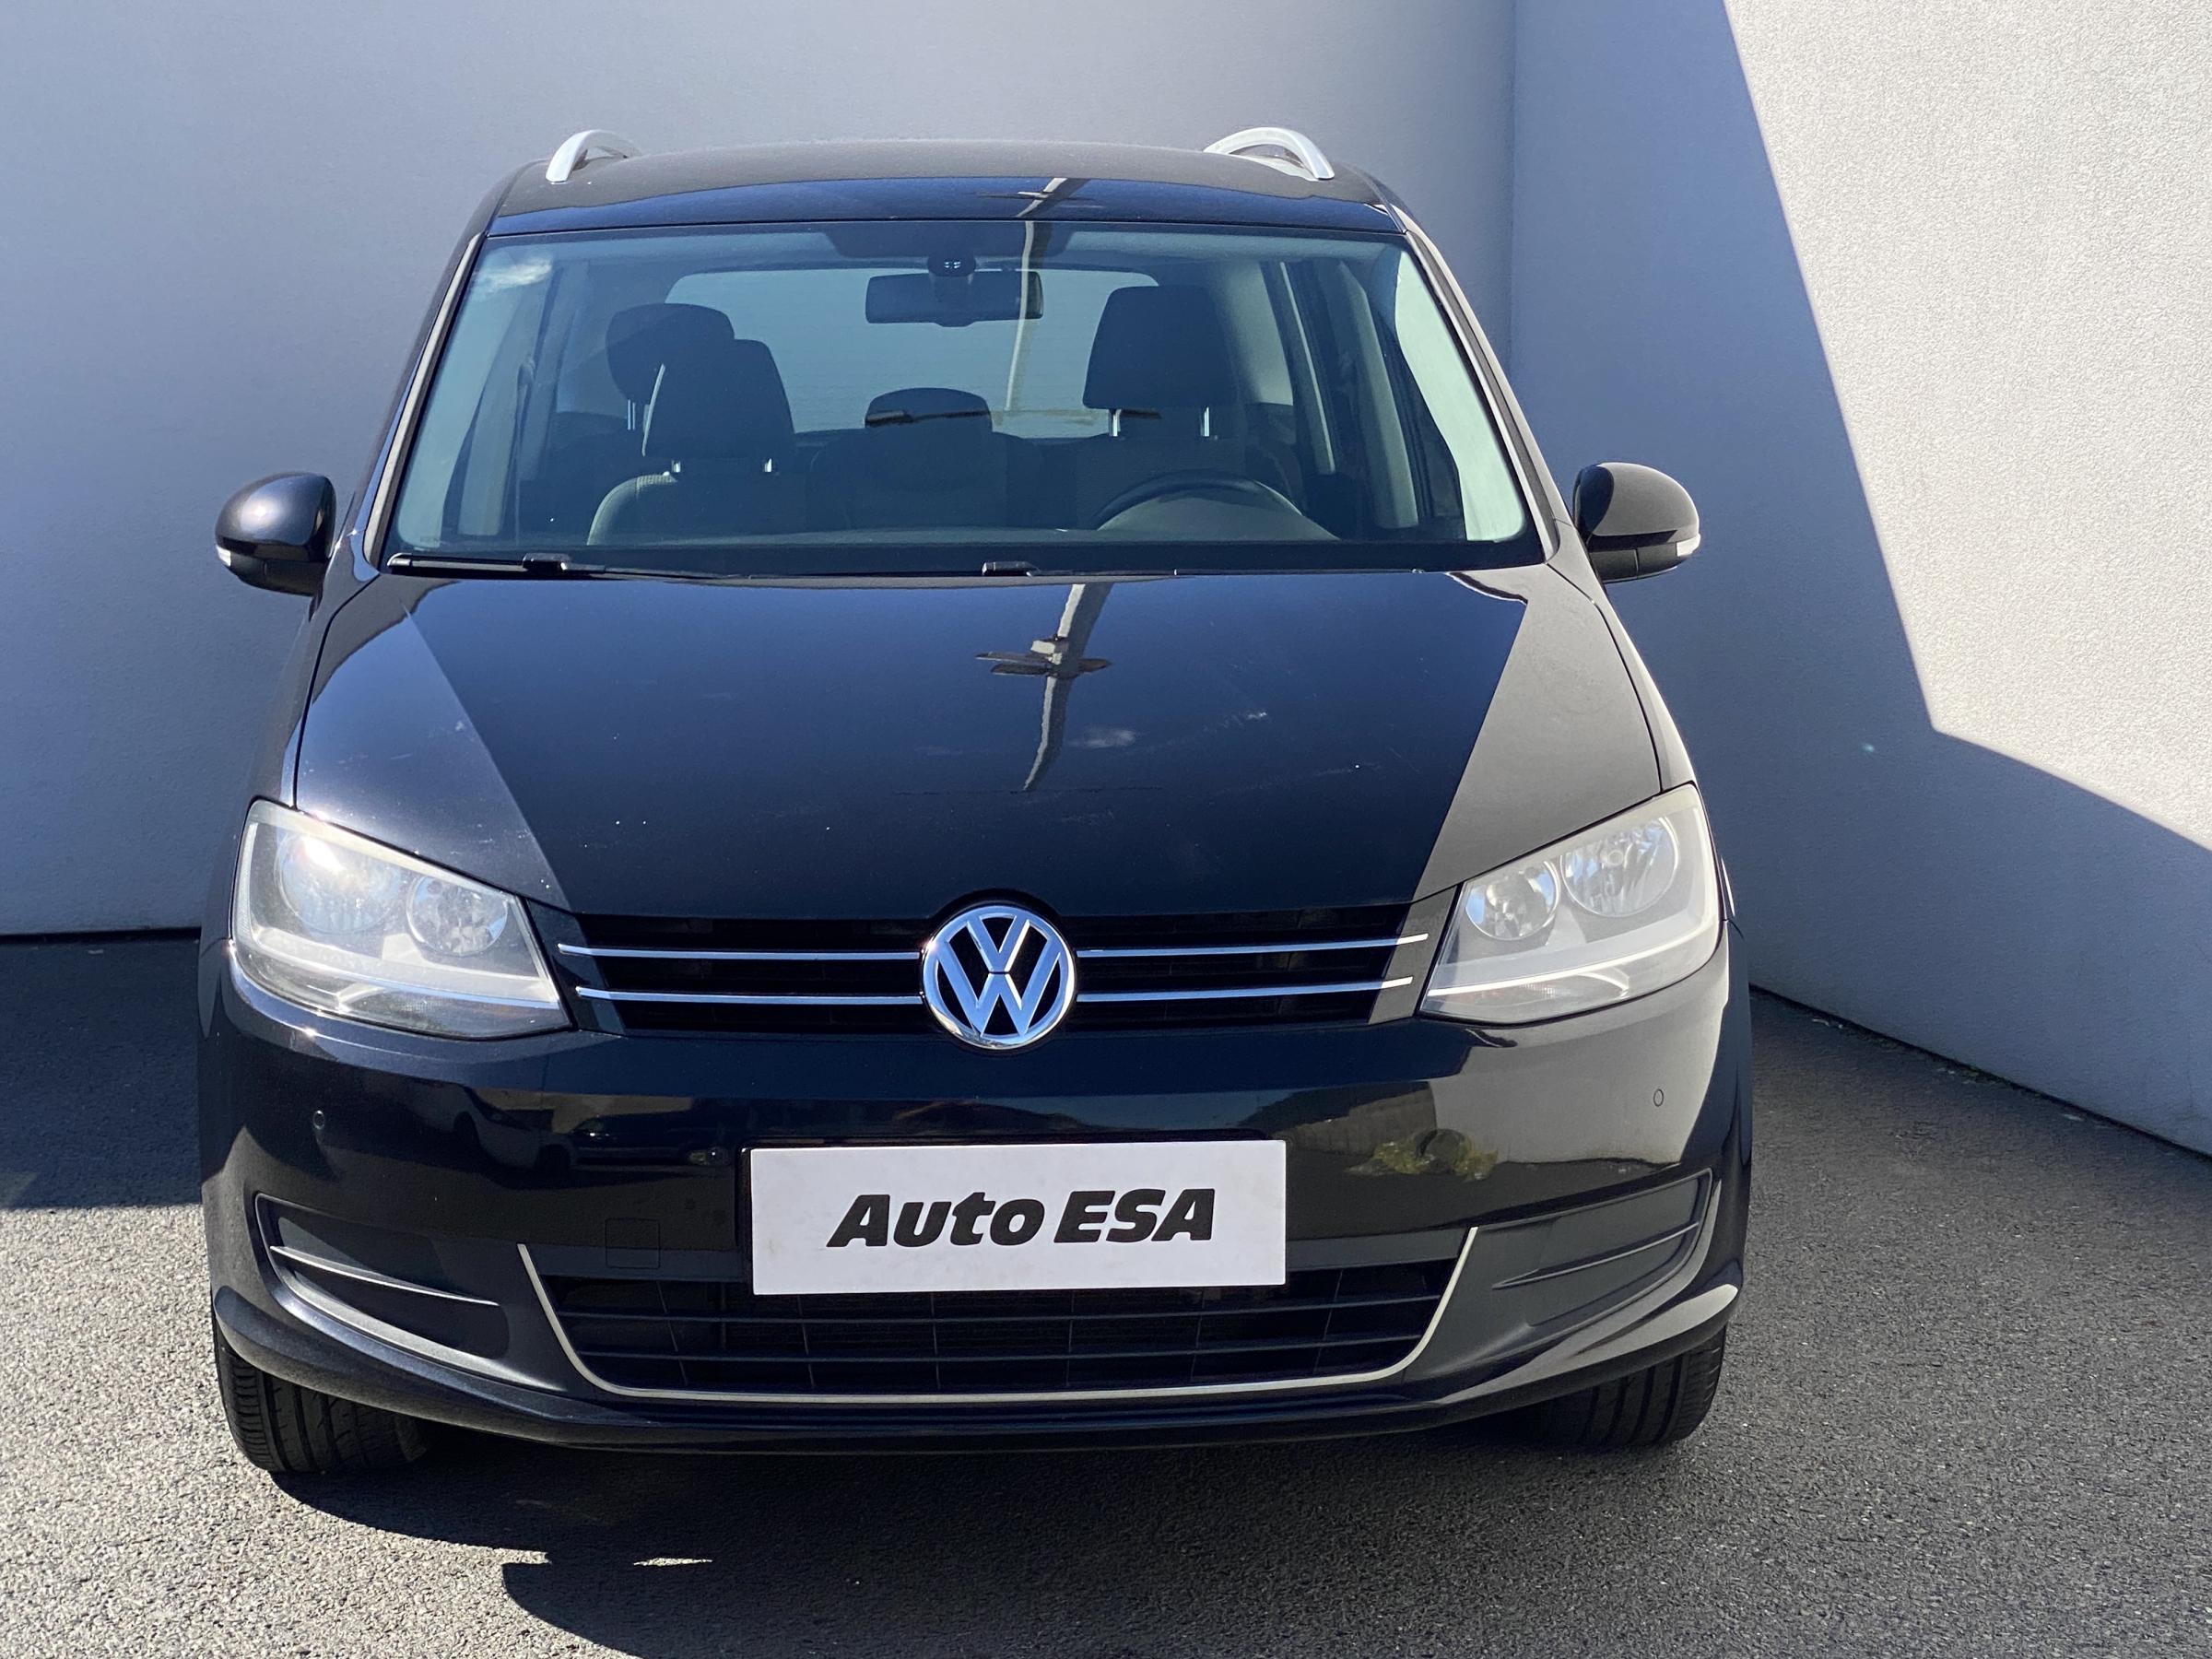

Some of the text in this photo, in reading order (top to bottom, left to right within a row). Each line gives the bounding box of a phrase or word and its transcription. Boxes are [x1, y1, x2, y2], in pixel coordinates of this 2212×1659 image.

[932, 908, 1066, 1041] VW
[827, 1188, 1215, 1247] Auto ESA
